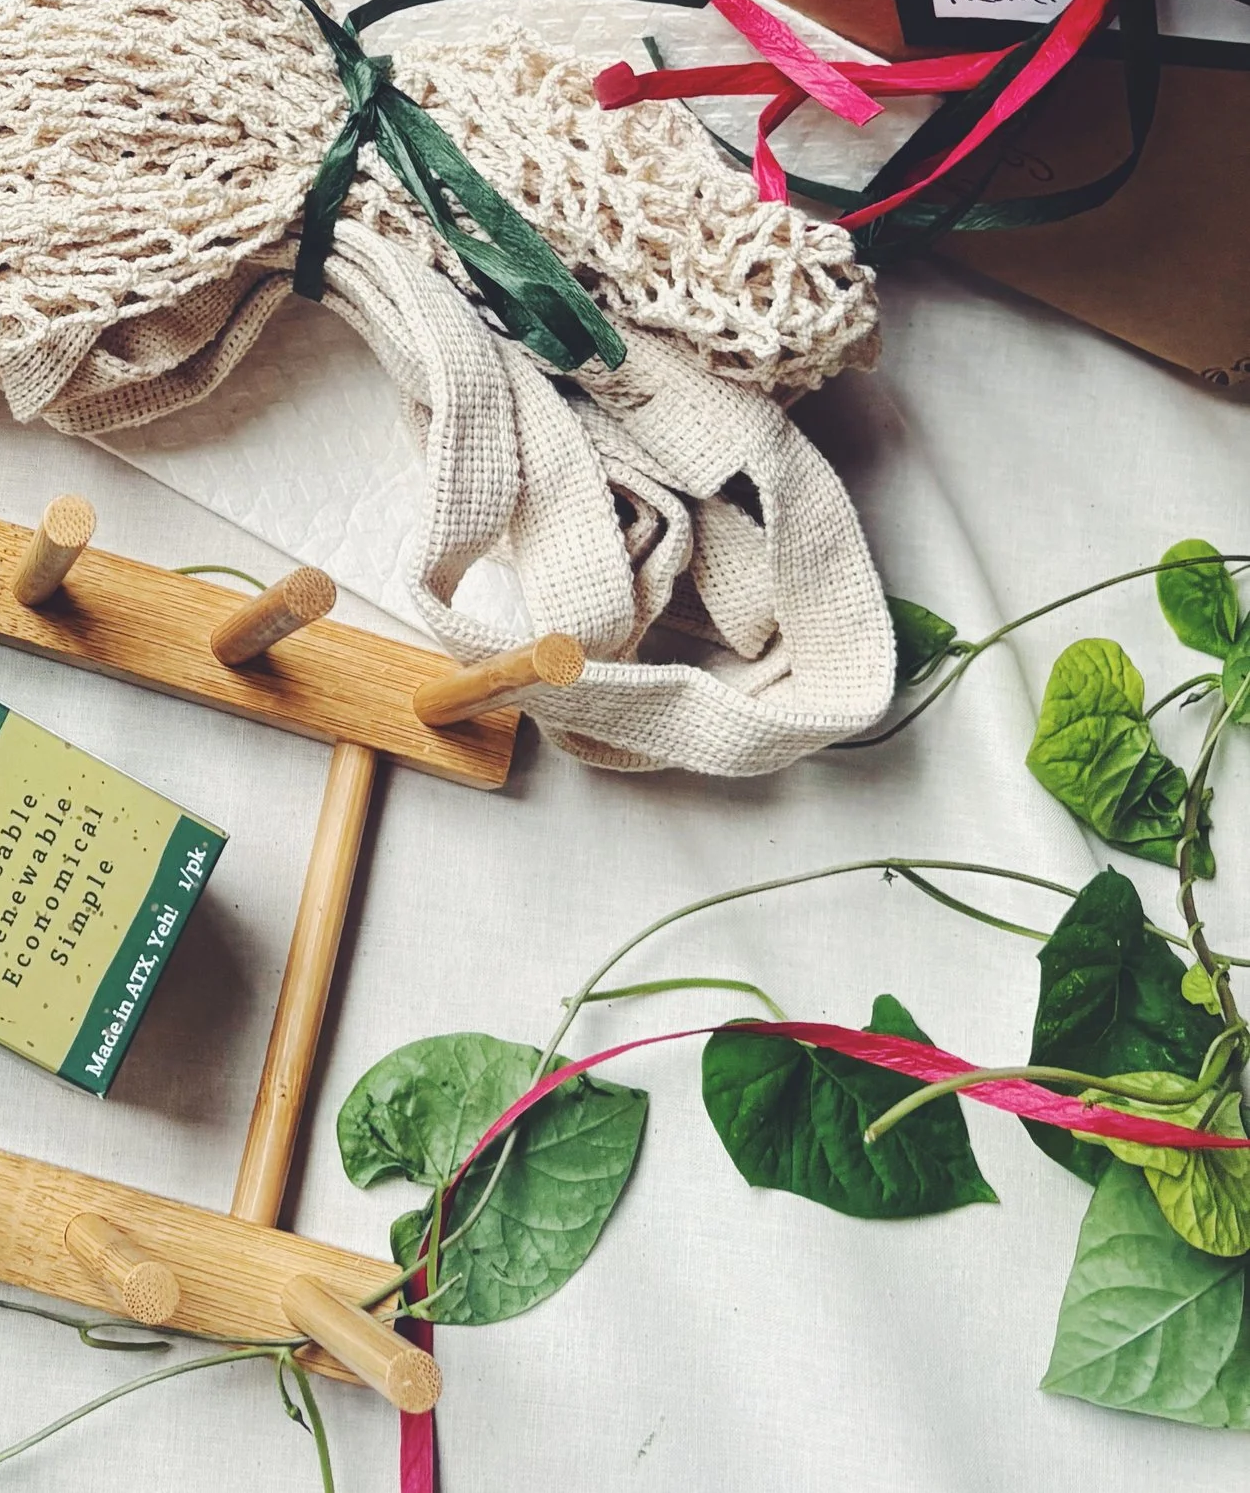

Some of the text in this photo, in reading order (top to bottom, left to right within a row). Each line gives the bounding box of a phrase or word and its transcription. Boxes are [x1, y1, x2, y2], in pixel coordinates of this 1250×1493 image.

[1, 807, 104, 988] Economical
[50, 859, 113, 966] Simple
[85, 846, 206, 1078] Made in ATX, Yeh! 1/pk
